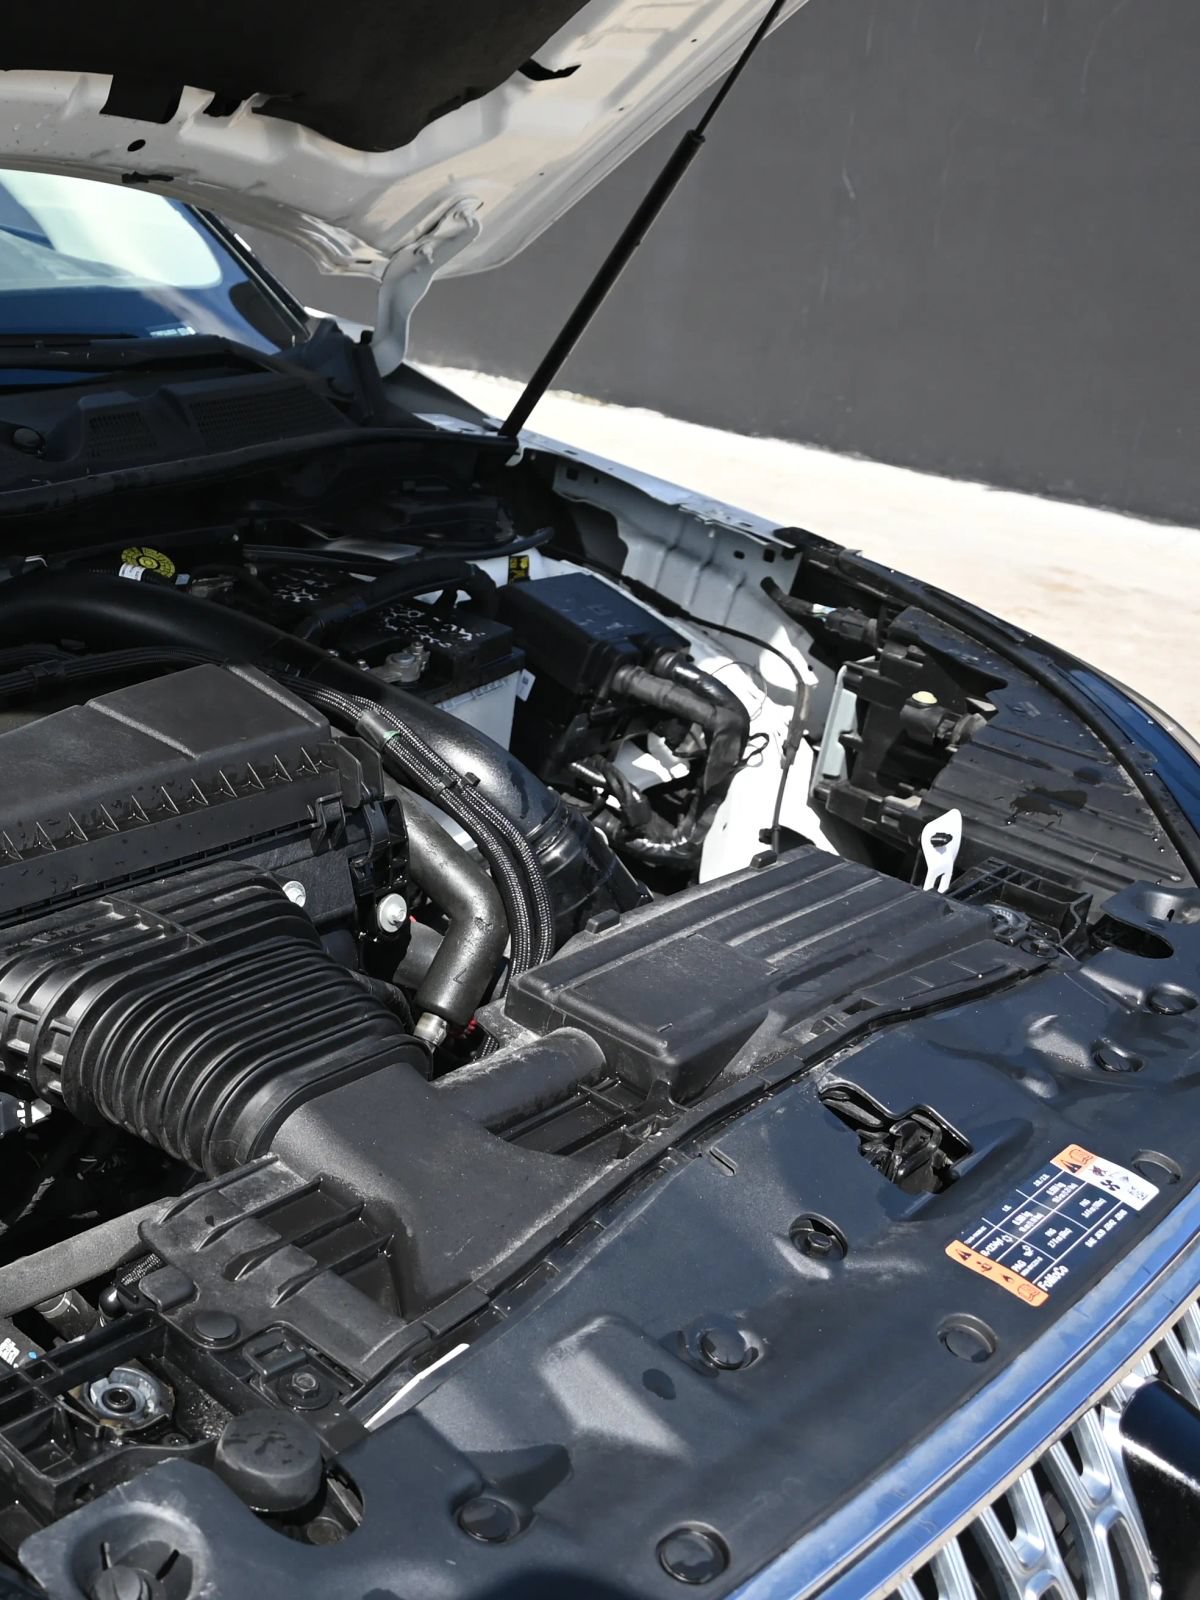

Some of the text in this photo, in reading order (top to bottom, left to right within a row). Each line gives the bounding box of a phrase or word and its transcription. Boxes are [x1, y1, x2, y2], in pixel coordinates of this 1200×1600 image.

[1011, 1259, 1027, 1272] PAG
[1037, 1265, 1069, 1292] FoMoCo
[1084, 1236, 1098, 1248] SAE
